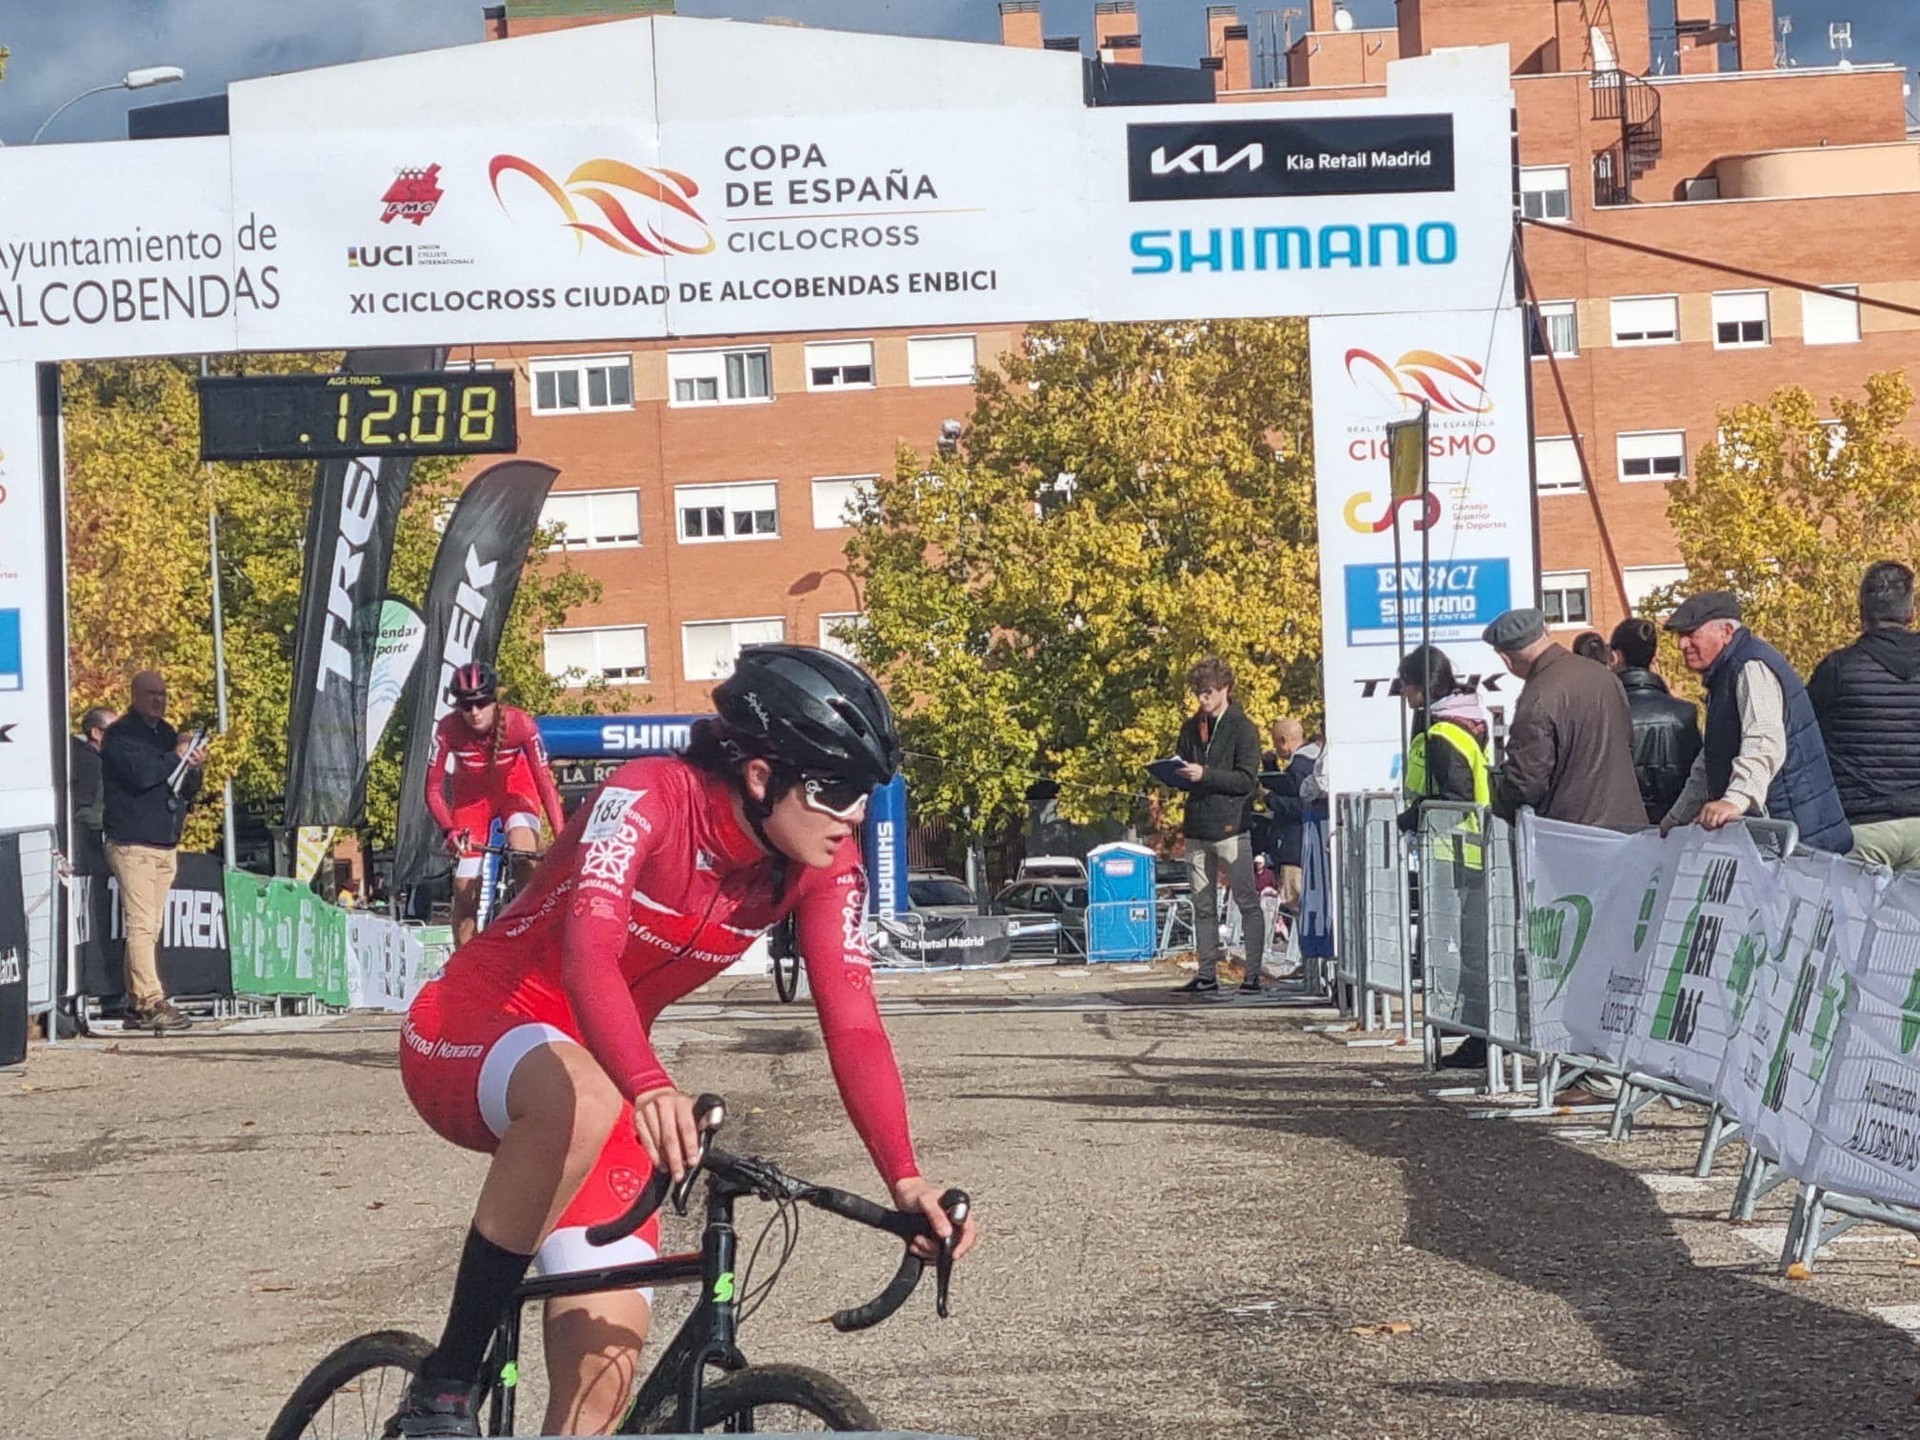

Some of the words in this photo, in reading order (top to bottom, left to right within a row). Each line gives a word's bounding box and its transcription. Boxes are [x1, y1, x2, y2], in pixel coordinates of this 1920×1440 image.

[724, 142, 828, 171] COPA
[1286, 154, 1314, 171] Kia
[1318, 151, 1367, 169] Retail
[1371, 150, 1431, 167] Madrid
[725, 181, 774, 208] DE
[787, 168, 938, 203] ESPAÑA
[237, 211, 278, 252] de
[727, 225, 920, 253] CICLOCROSS
[360, 245, 414, 267] UCI
[1129, 220, 1458, 275] SHIMANO
[350, 293, 375, 314] XI
[382, 287, 556, 314] CICLOCROSS
[564, 284, 670, 308] CIUDAD
[679, 281, 713, 303] DE
[720, 273, 899, 302] ALCOBENDAS
[908, 269, 998, 294] ENBICI
[1348, 433, 1496, 462] CICSMO
[316, 456, 382, 692] TRE
[602, 724, 692, 750] SHIM
[593, 798, 628, 825] 183
[877, 821, 895, 920] SHIMANO
[163, 888, 227, 950] TREK
[949, 935, 985, 948] Madrid
